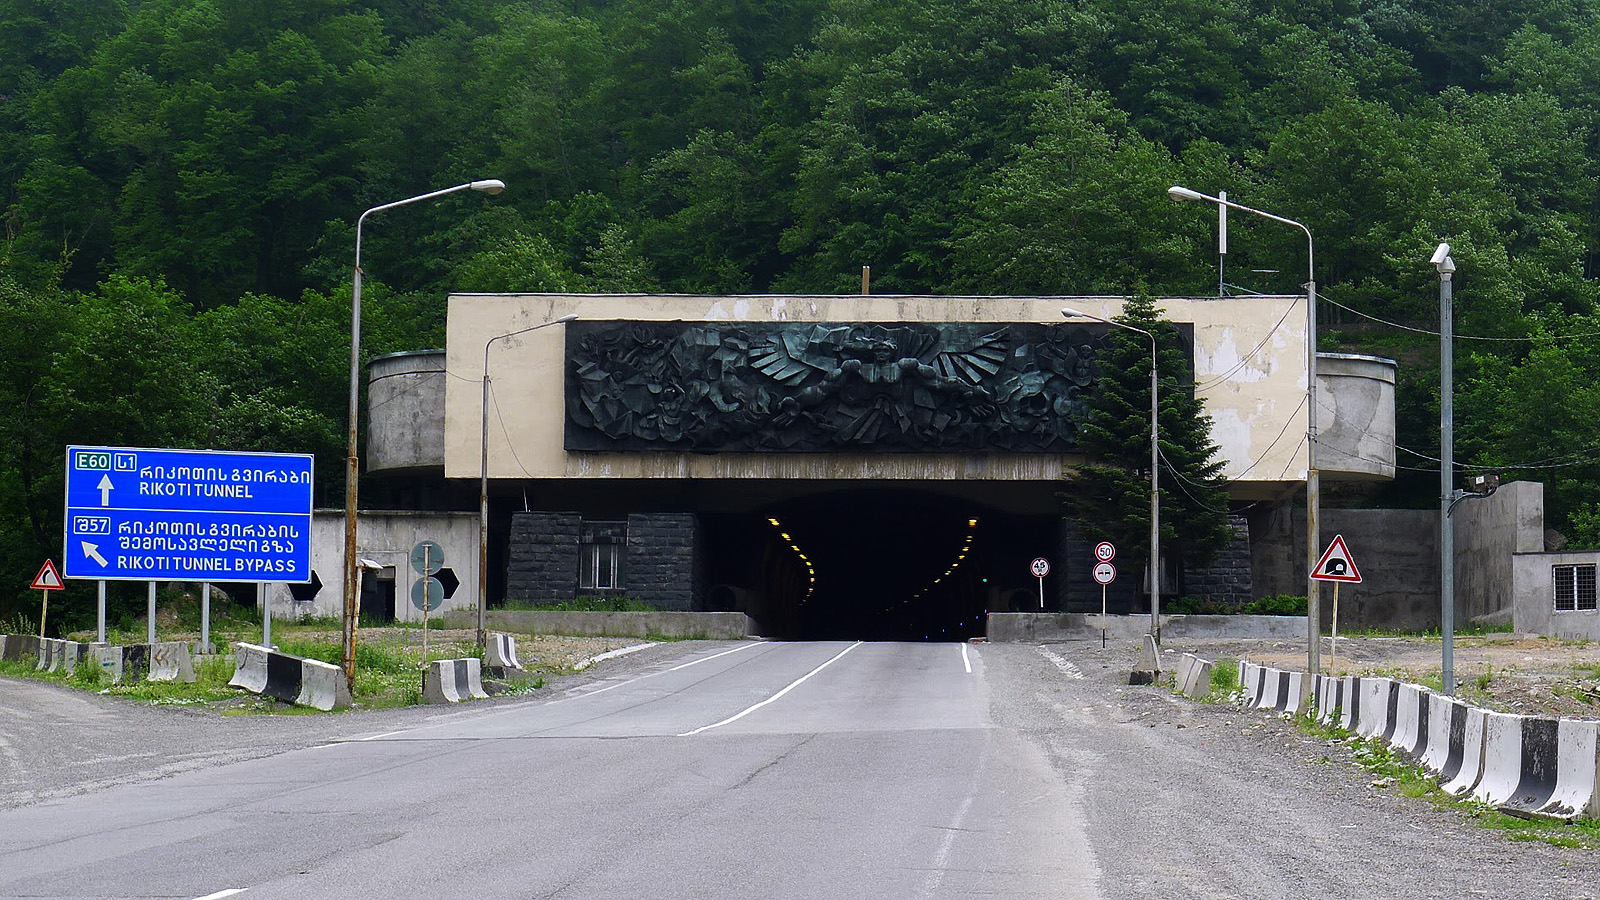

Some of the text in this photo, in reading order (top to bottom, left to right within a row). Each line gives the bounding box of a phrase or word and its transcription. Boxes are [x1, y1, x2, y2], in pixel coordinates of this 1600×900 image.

[79, 454, 108, 468] E60
[140, 465, 310, 484] რიკოთის გვირაბი
[139, 482, 253, 498] RIKOTI TUNNEL
[77, 518, 108, 532] შ57
[118, 520, 299, 538] რიკოთის გვირაბის
[118, 536, 294, 553] შემოსავლელი გზა
[1100, 548, 1110, 556] 50
[117, 555, 296, 572] RIKOTI TUNNEL BYPASS
